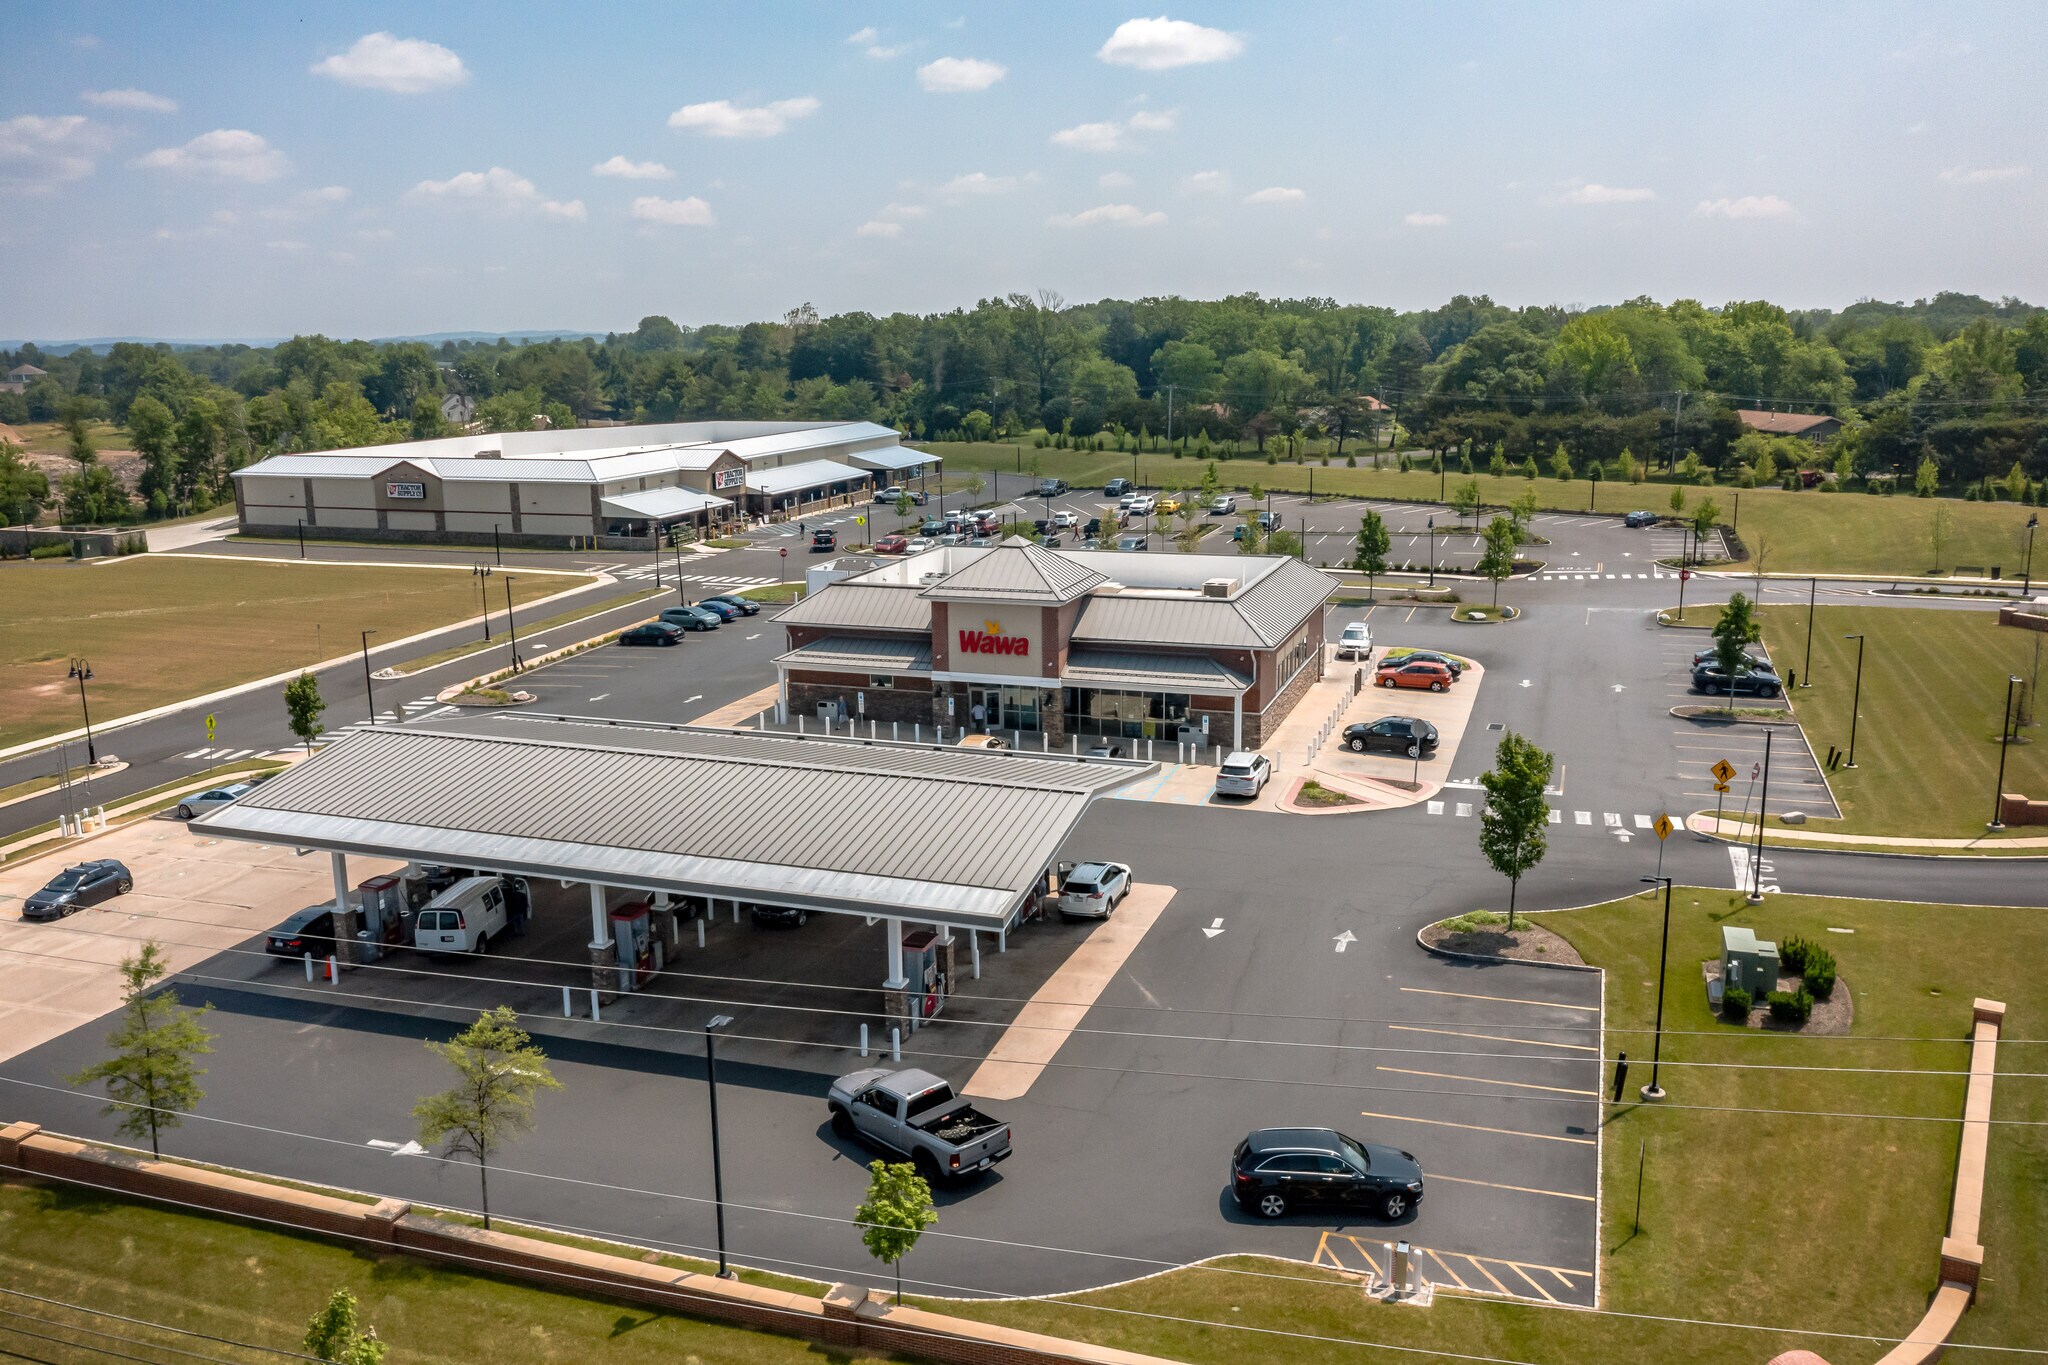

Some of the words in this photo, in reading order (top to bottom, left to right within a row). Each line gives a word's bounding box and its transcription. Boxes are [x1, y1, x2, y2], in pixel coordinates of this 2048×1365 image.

[724, 469, 743, 479] TRACTOR
[724, 478, 739, 487] SUPPLY
[959, 629, 1029, 656] Wawa
